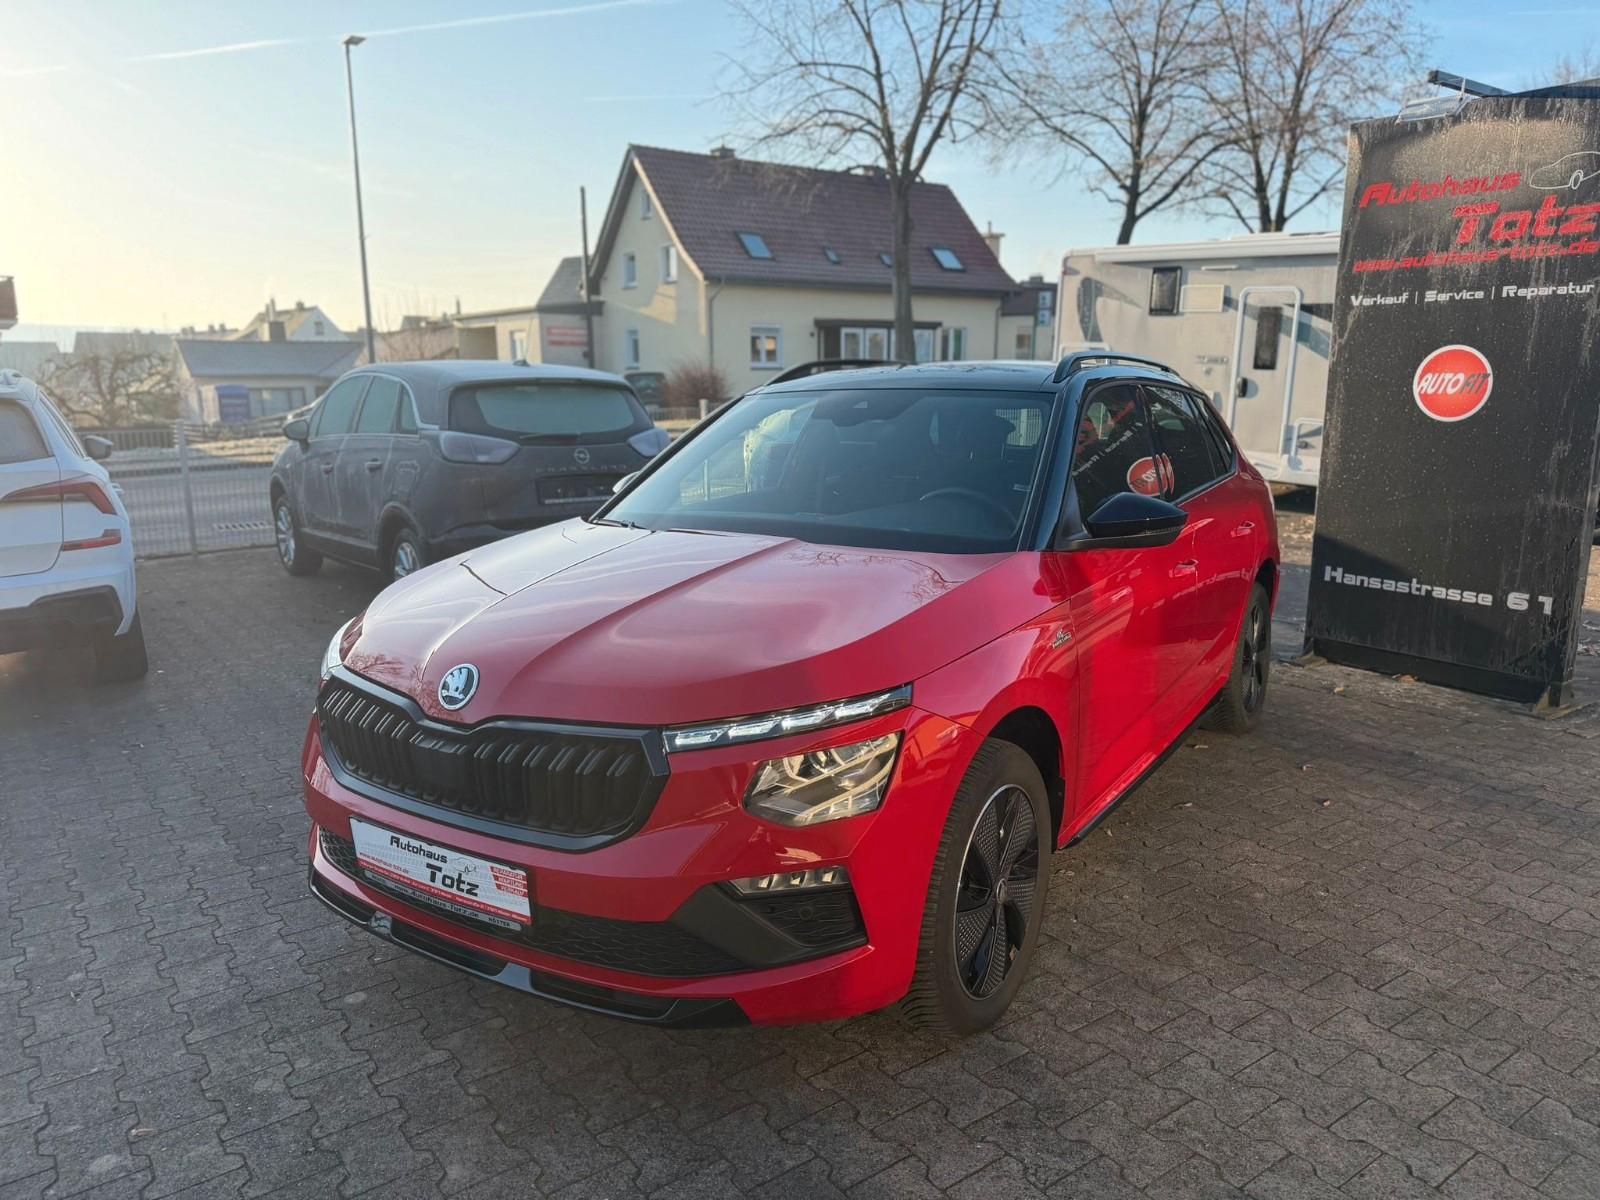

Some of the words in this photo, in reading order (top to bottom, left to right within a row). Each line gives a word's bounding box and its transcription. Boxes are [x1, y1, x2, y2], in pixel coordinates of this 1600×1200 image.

[1359, 172, 1521, 208] Autohaus
[1452, 195, 1600, 244] Totz
[1351, 291, 1409, 307] Verkauf
[1424, 288, 1485, 303] Service
[1502, 281, 1595, 299] Reparatur
[1324, 565, 1493, 606] Hansastrasse
[390, 835, 448, 864] Autohaus
[426, 862, 480, 897] Totz
